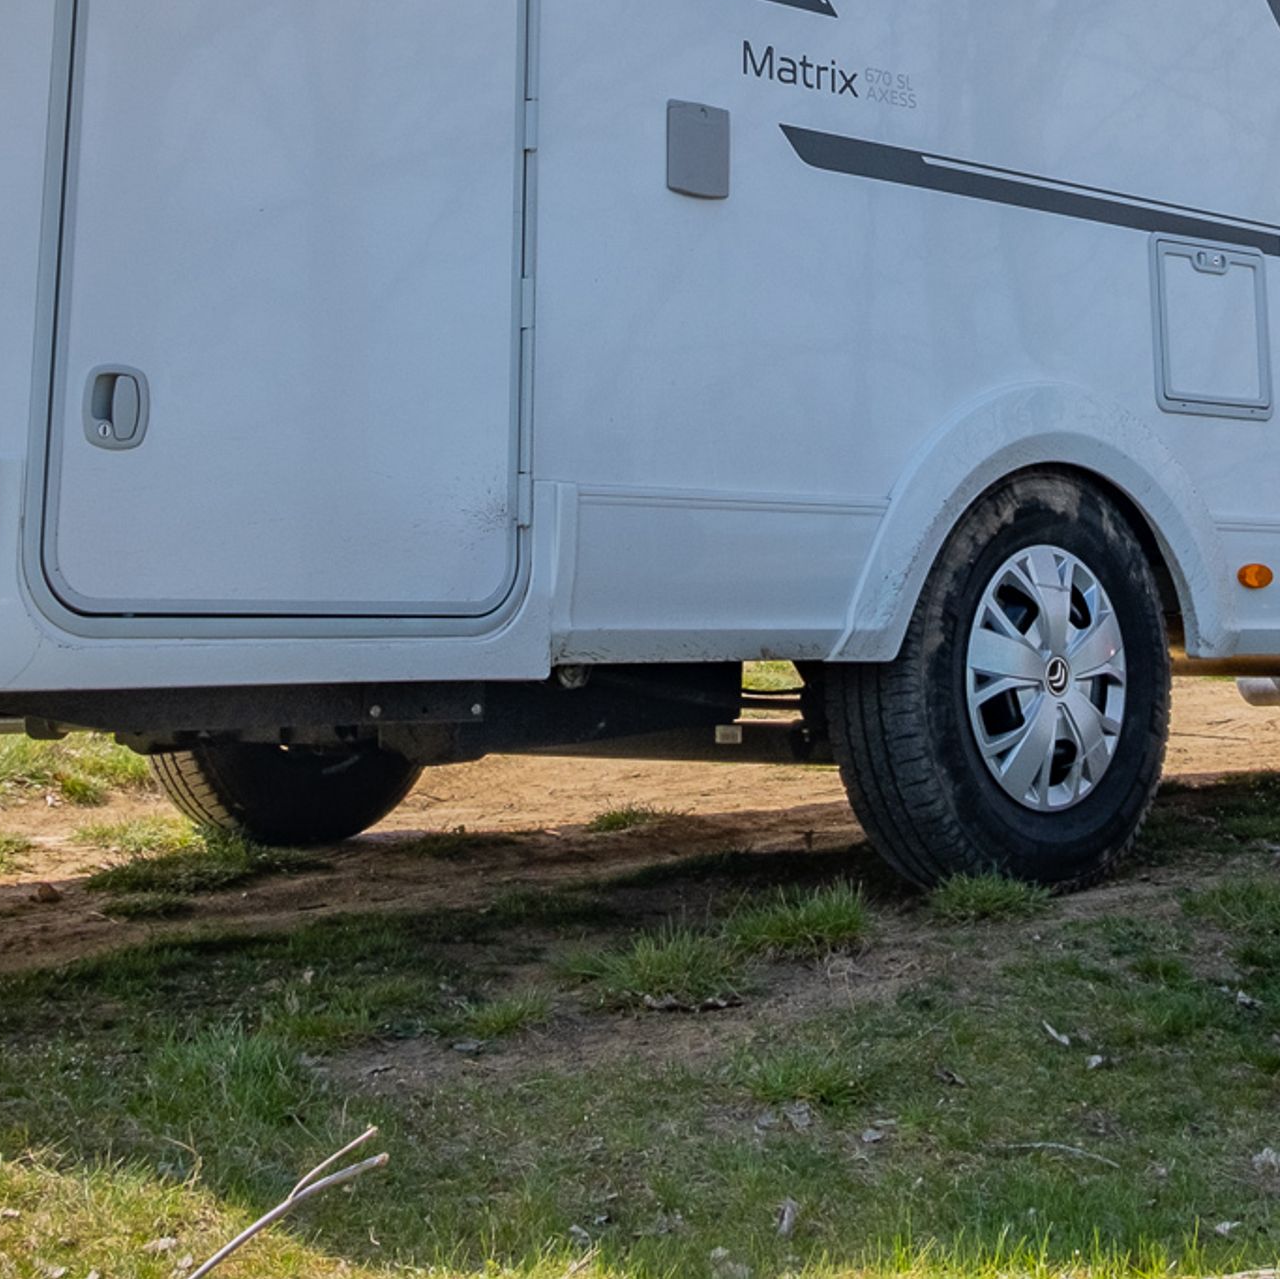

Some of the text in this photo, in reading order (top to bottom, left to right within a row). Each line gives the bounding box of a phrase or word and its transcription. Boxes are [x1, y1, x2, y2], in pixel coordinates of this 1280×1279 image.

[742, 39, 913, 98] Matrix 670 SL
[866, 86, 917, 109] AXESS
